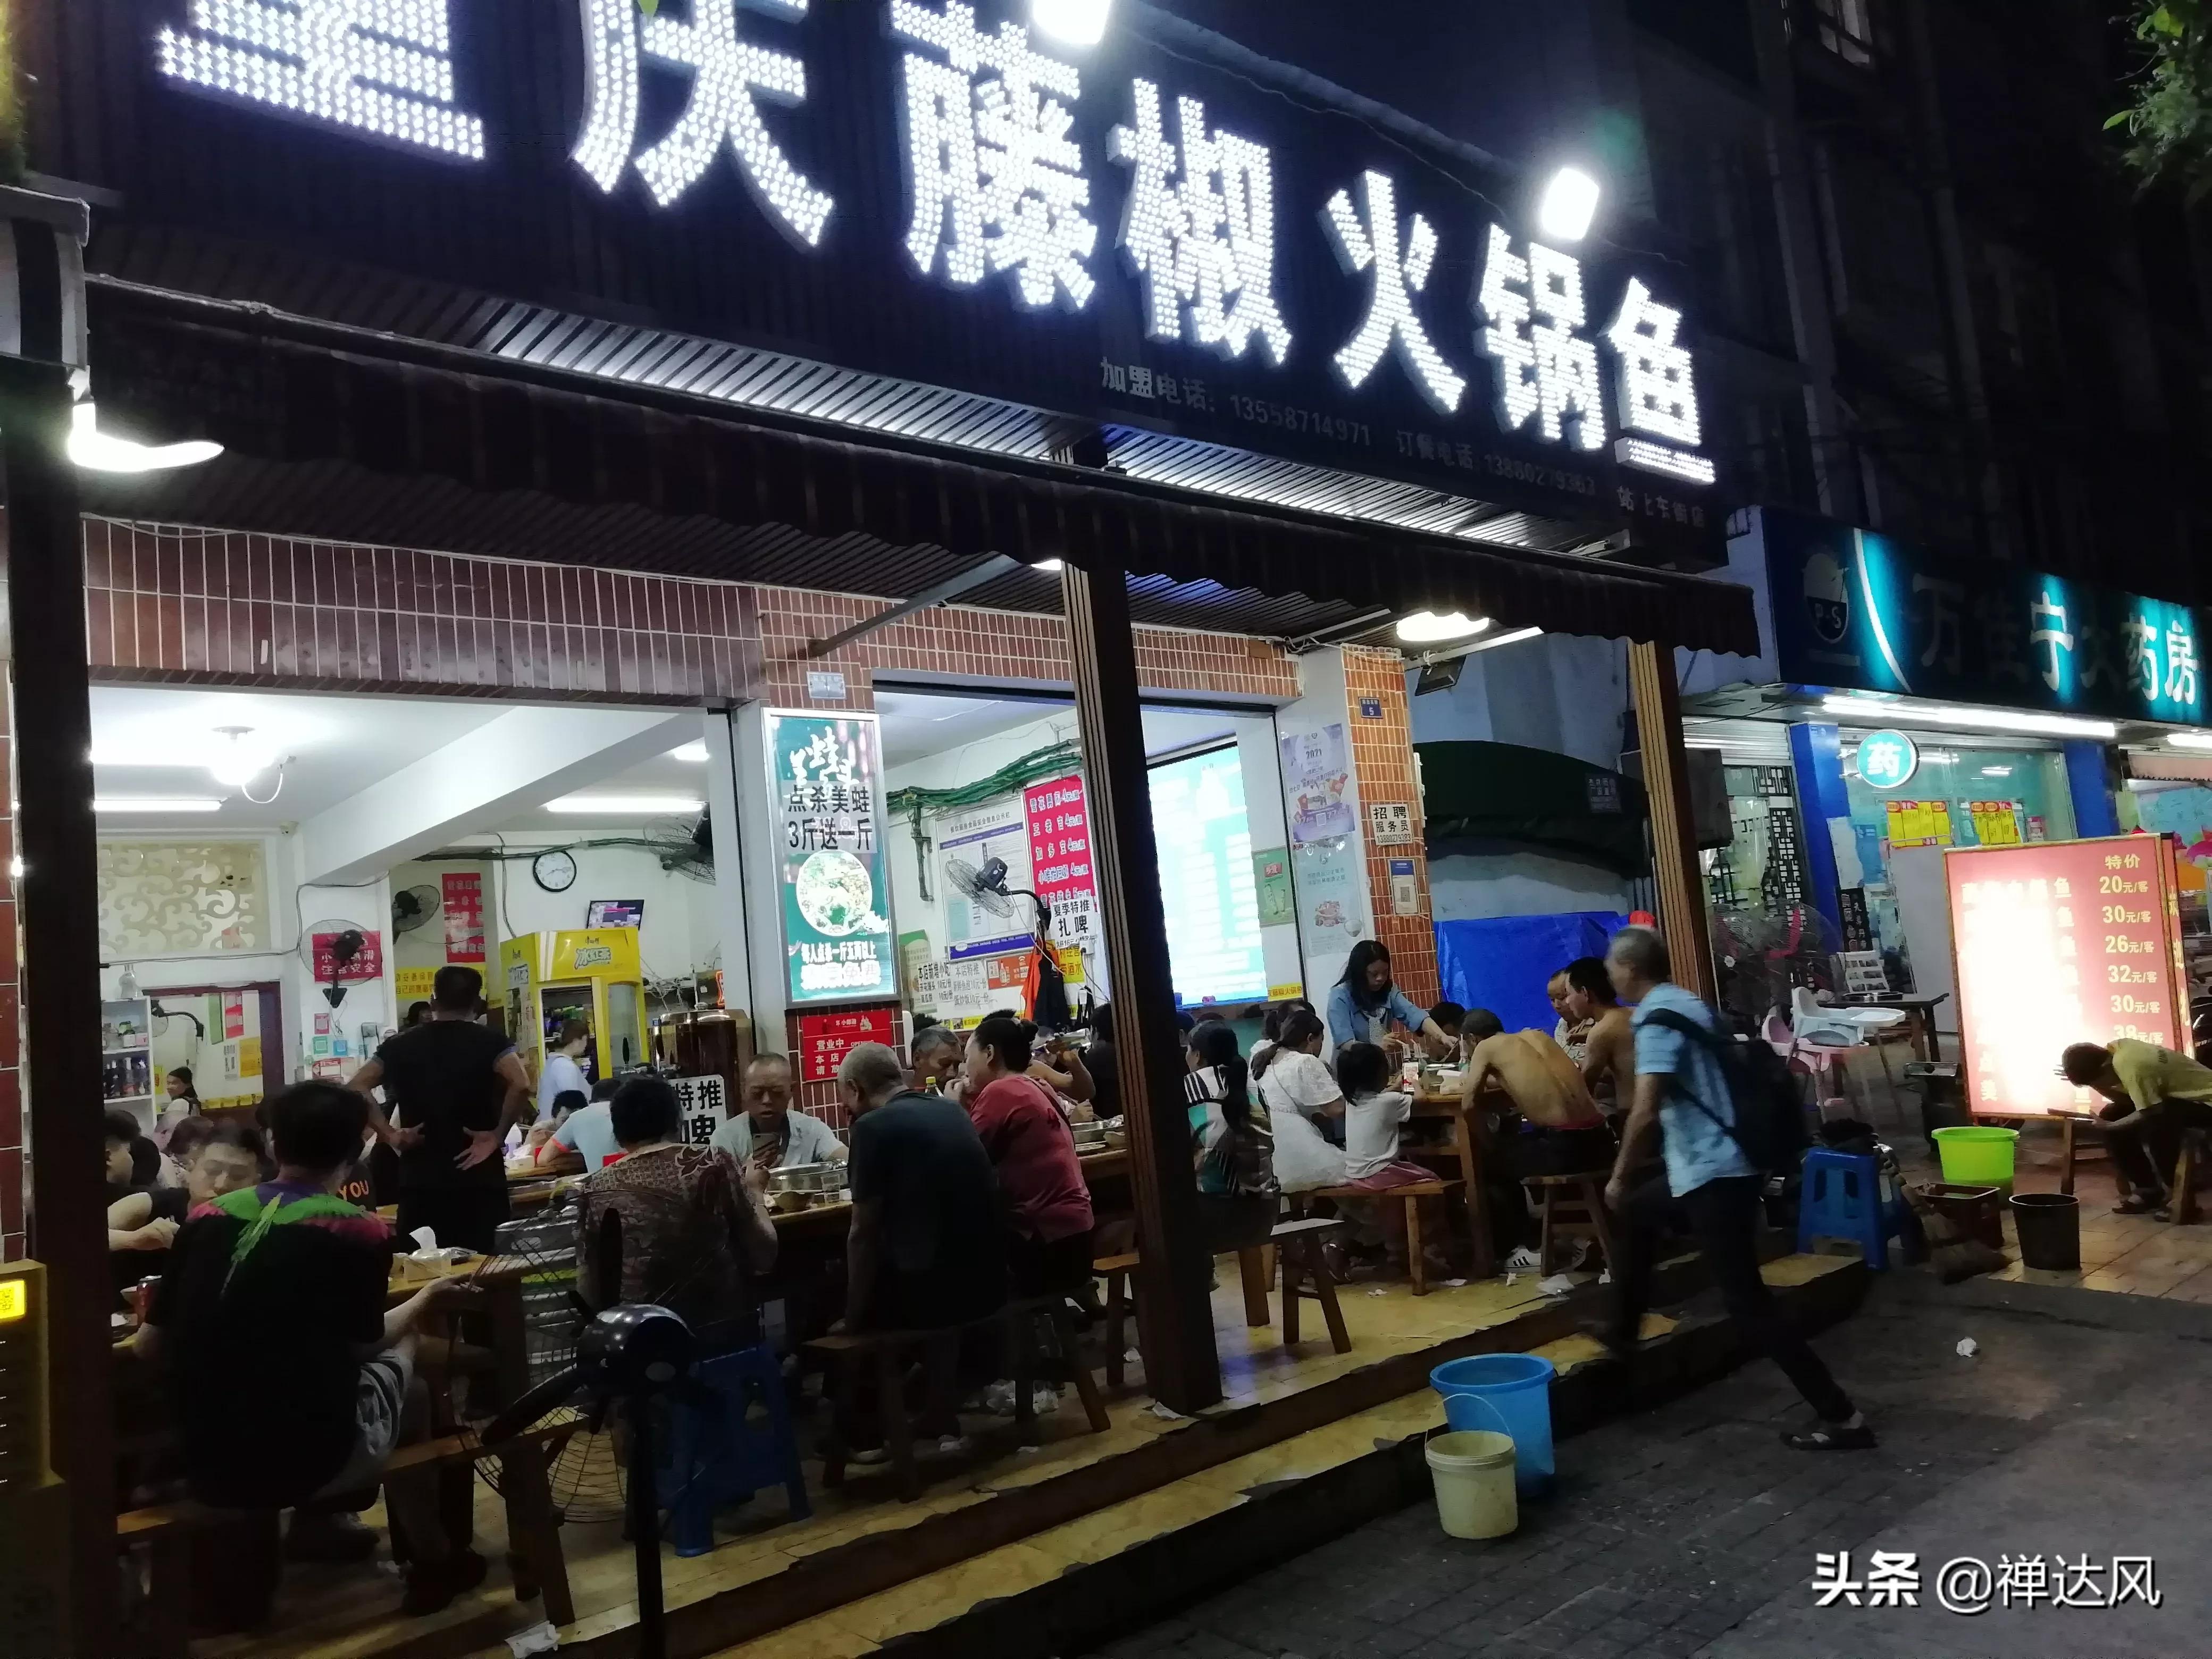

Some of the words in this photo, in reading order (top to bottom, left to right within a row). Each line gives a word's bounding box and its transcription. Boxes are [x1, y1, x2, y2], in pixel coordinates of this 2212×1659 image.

[1866, 742, 1901, 777] 药
[787, 785, 872, 814] 点杀美蛙
[1373, 806, 1407, 819] 招聘
[788, 817, 873, 851] 3斤送一斤
[1376, 820, 1409, 833] 服务员
[2105, 854, 2141, 870] 特价
[2099, 875, 2149, 895] 20元/客
[1053, 899, 1090, 917] 夏季特推
[2102, 906, 2151, 924] 30元/客
[1058, 915, 1088, 937] 扎啤
[2105, 935, 2155, 954] 26元/客
[2108, 965, 2157, 984] 32元/客
[2110, 995, 2160, 1014] 30元/客
[816, 1038, 844, 1050] 营业中
[338, 1179, 369, 1201] YOU
